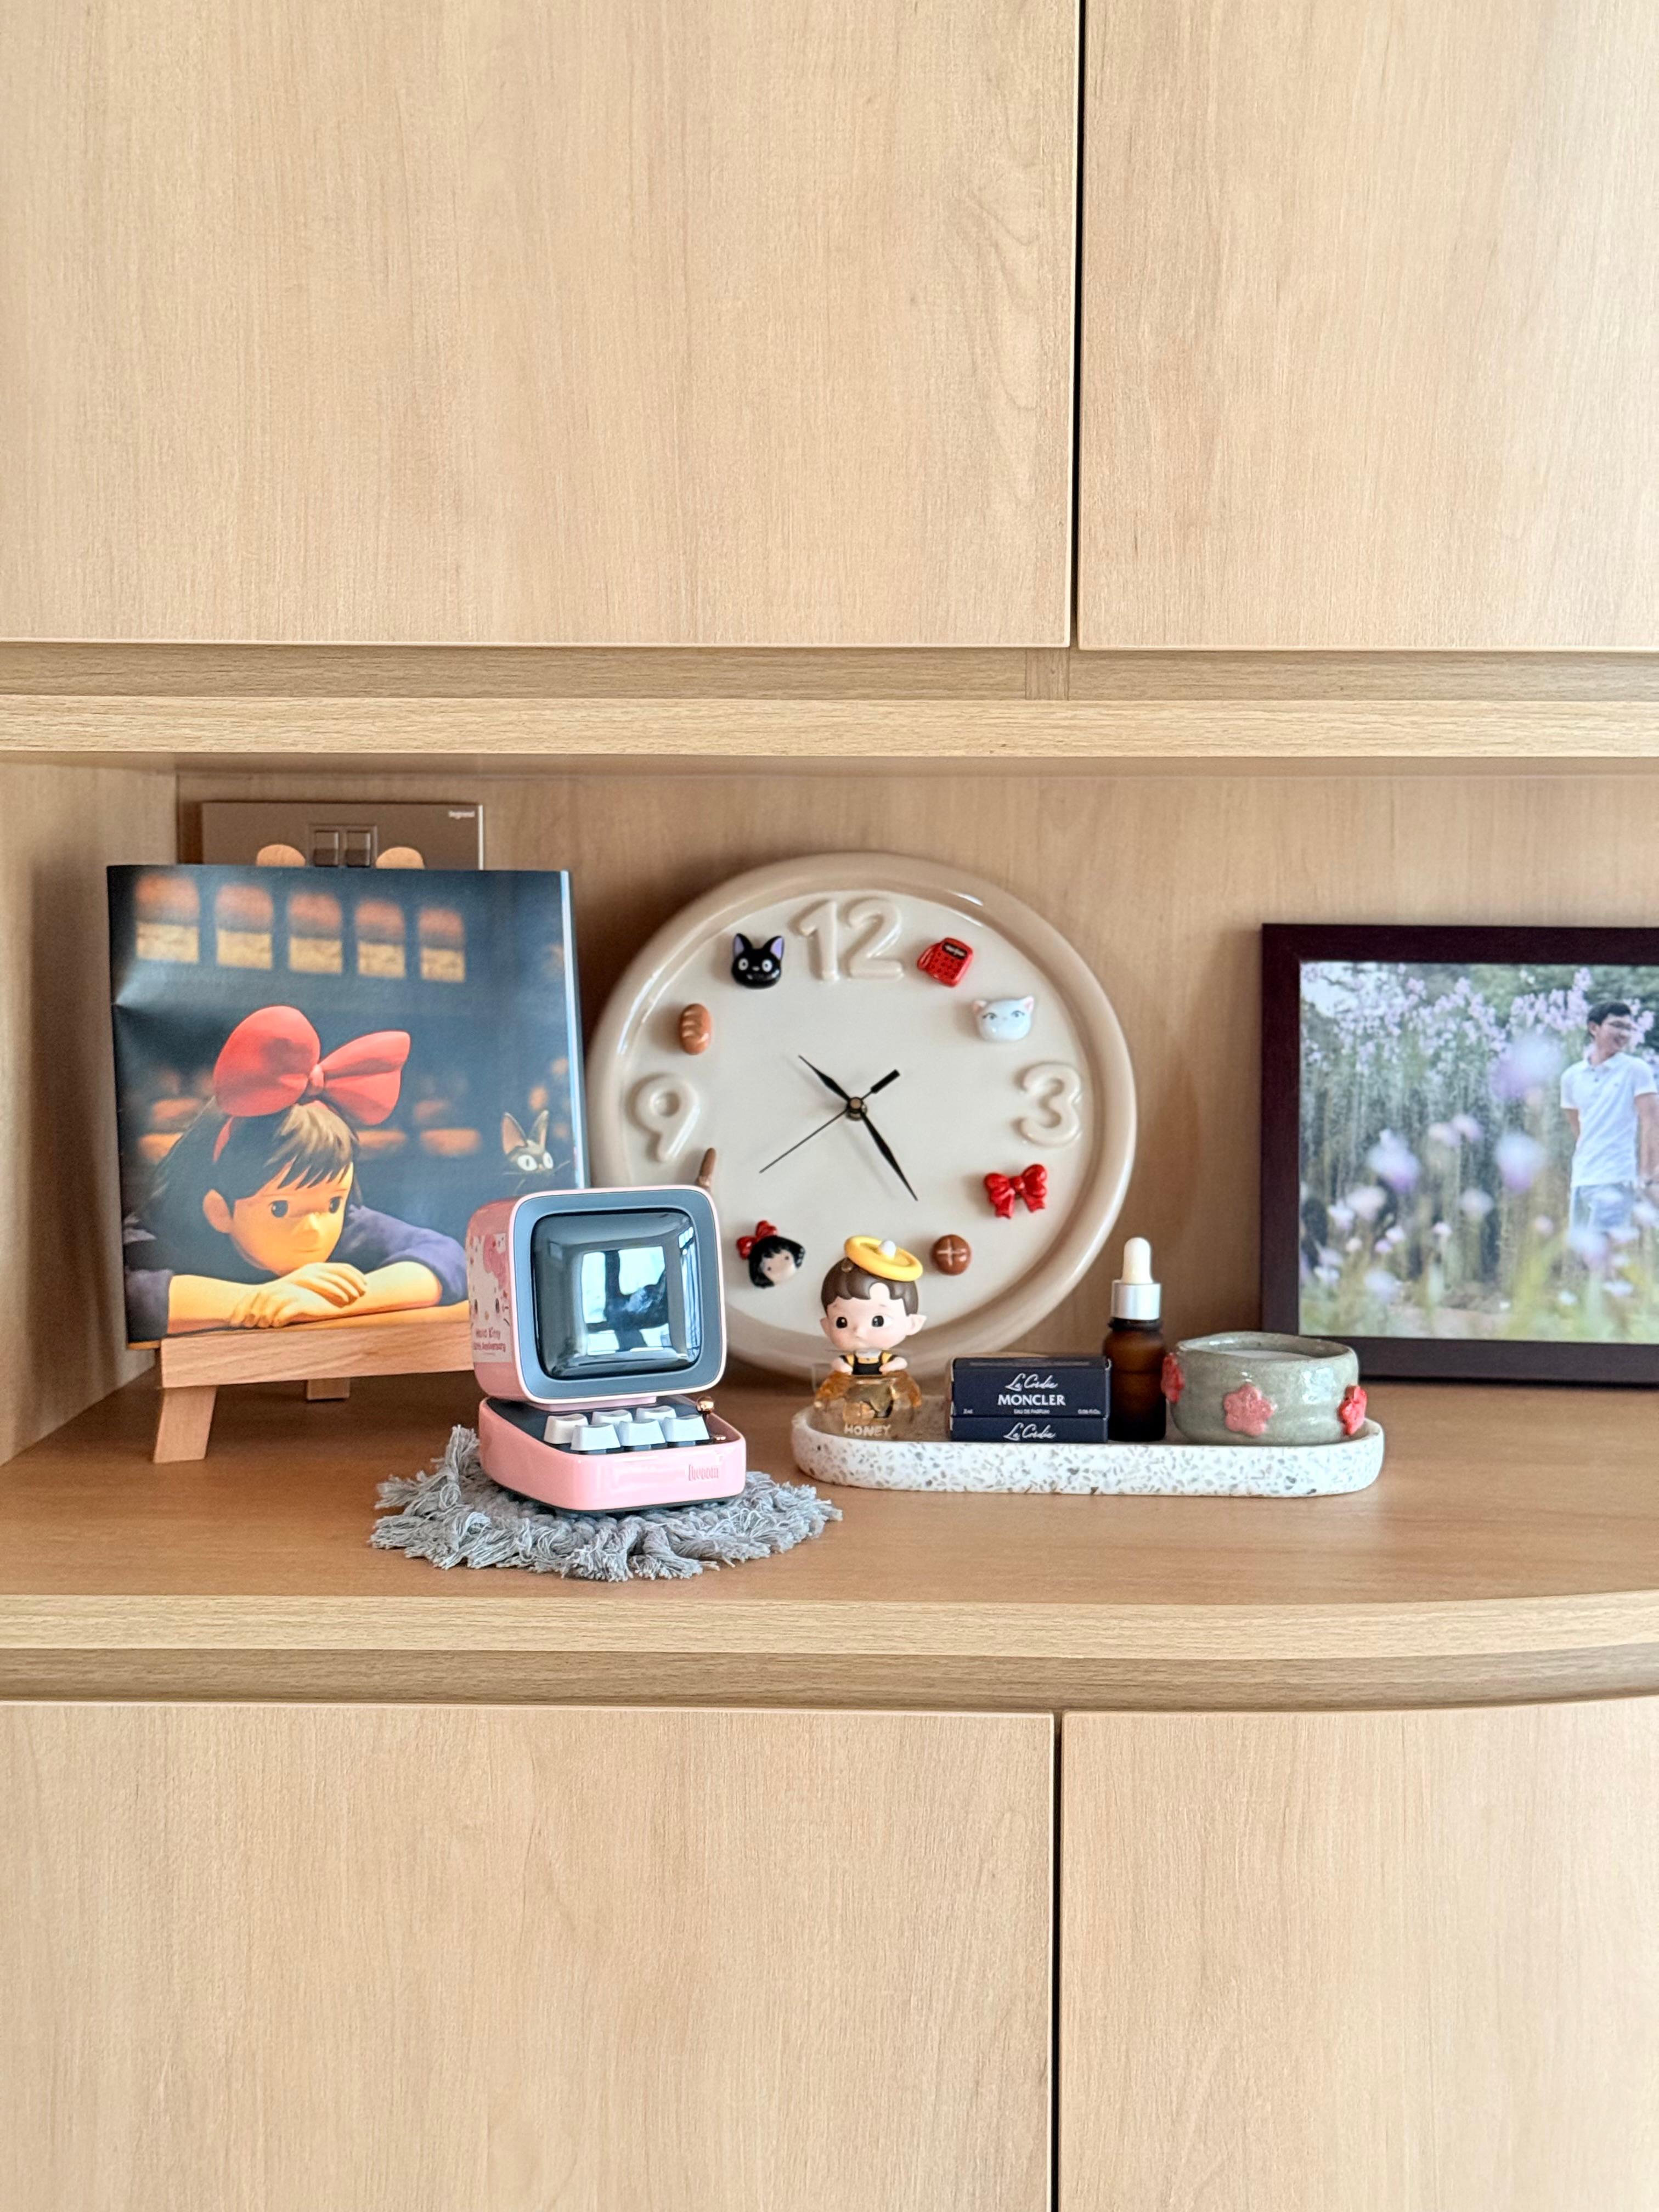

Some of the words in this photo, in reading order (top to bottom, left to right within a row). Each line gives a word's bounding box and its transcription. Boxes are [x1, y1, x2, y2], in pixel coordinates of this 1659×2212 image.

[788, 898, 904, 981] 12
[625, 1073, 700, 1163] 9
[1011, 1062, 1082, 1147] 3
[844, 1423, 891, 1436] HONEY
[997, 1394, 1066, 1406] MONCLER
